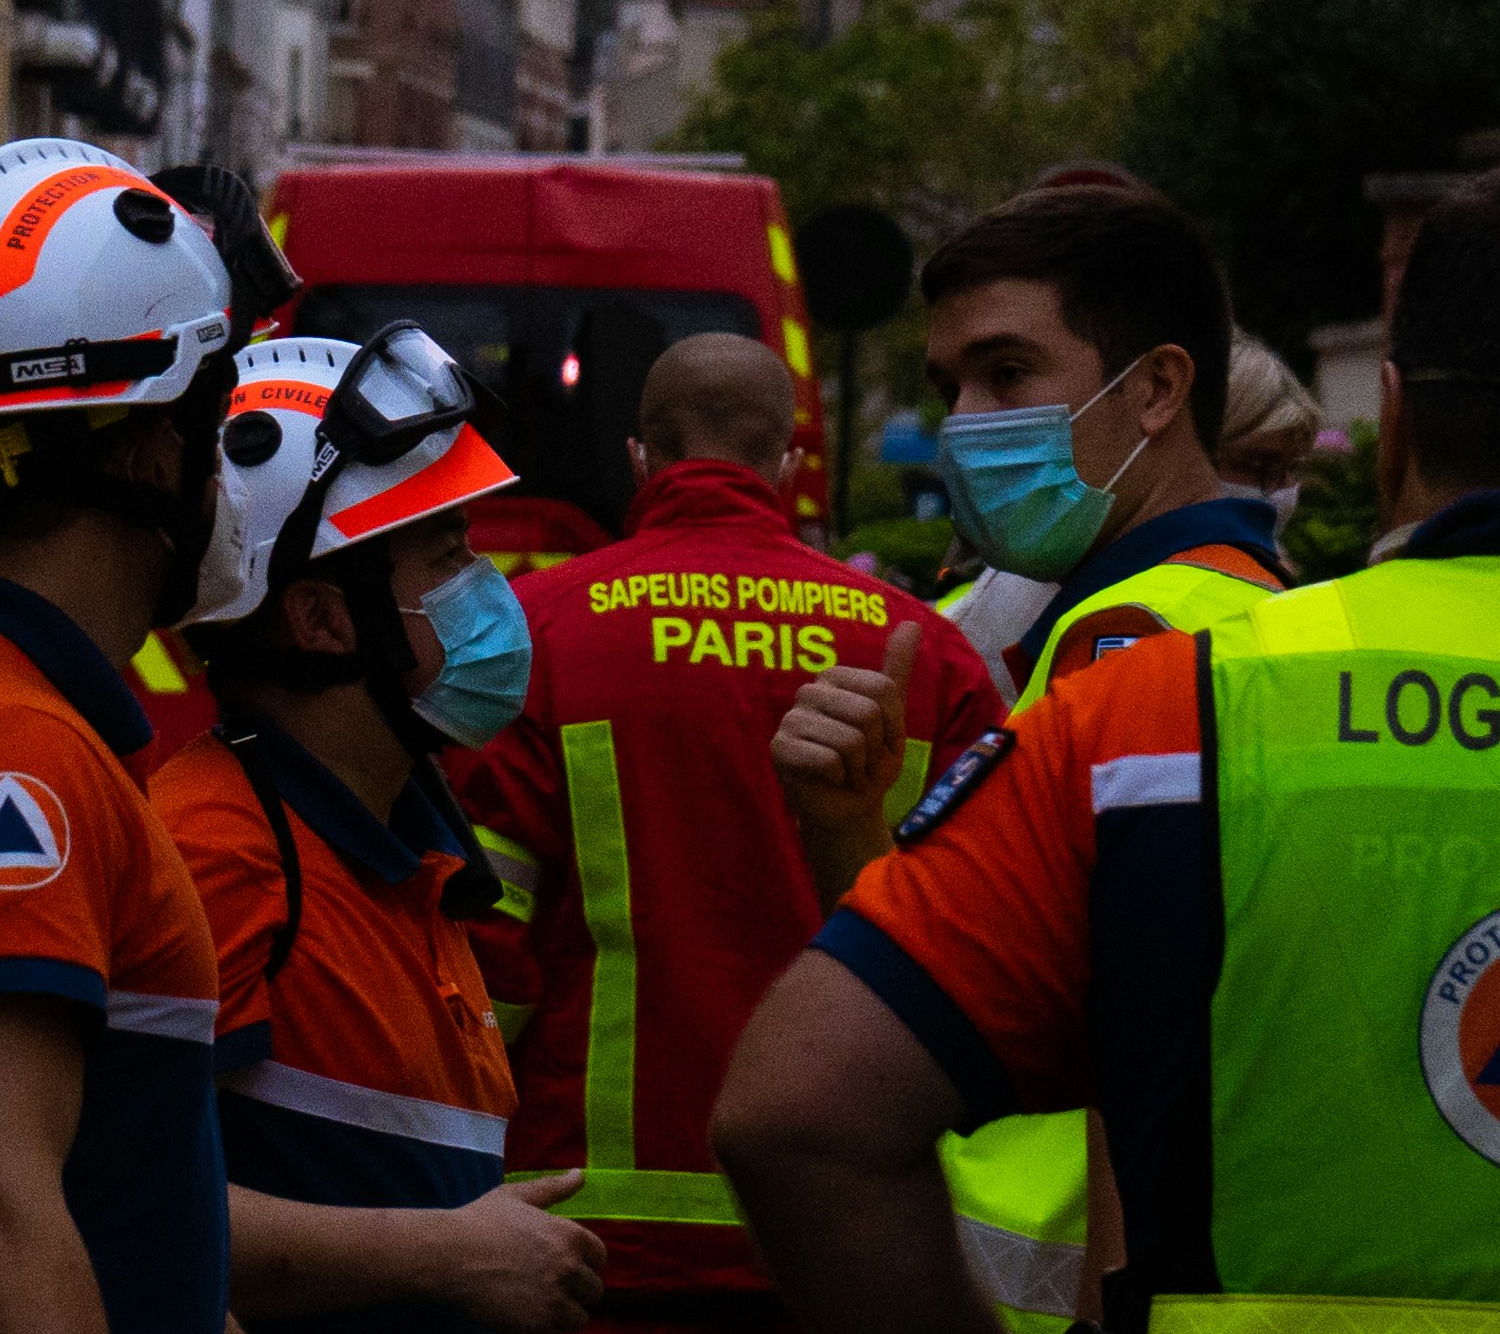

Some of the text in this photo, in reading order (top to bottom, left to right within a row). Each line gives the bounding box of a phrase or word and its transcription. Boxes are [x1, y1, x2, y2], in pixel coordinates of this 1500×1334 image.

[7, 171, 101, 250] PROTECTION
[16, 358, 81, 378] MSA
[261, 387, 329, 409] CIVILE
[311, 445, 336, 478] MS
[588, 573, 889, 627] SAPEURS POMPIERS
[652, 616, 839, 674] PARIS
